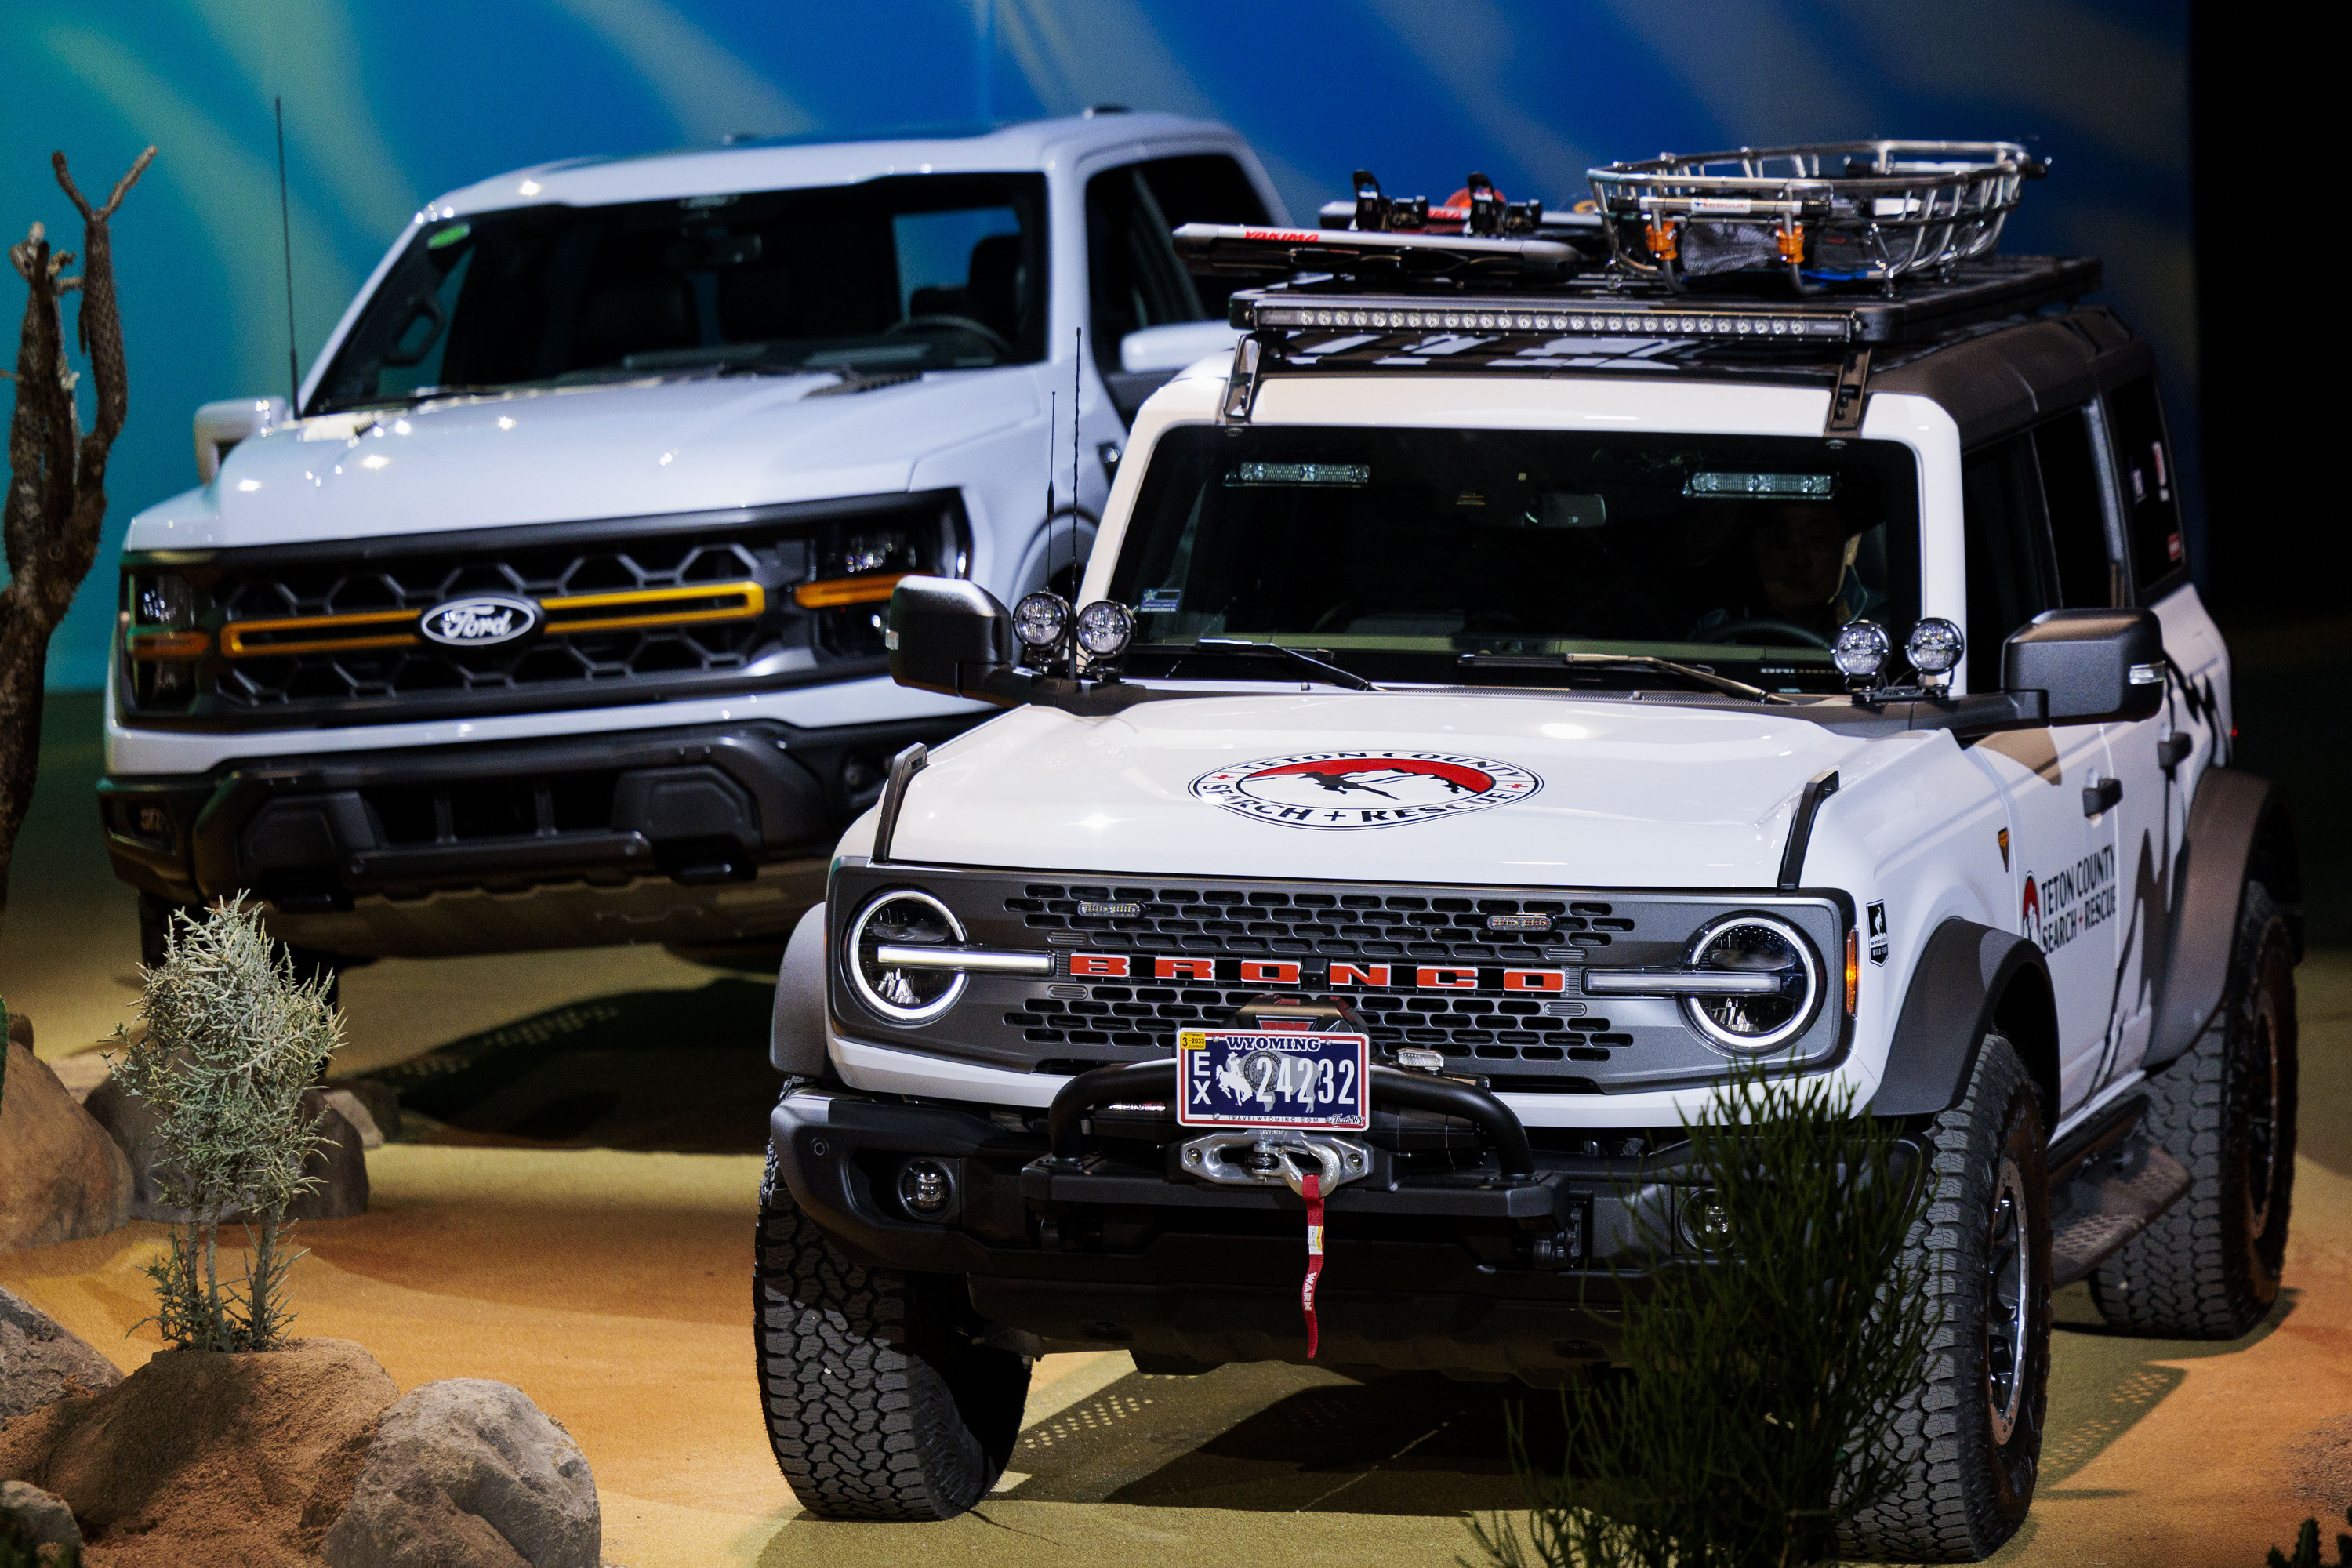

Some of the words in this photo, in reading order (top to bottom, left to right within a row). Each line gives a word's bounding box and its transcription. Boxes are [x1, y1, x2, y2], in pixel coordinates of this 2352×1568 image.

[1244, 230, 1319, 243] YAKIMA
[441, 605, 514, 639] Ford
[1236, 751, 1367, 770] TETON
[1382, 751, 1526, 779] COUNTY
[1203, 784, 1314, 821] SEARCH
[1361, 792, 1516, 822] RESCUE
[2041, 866, 2075, 919] TETON
[2076, 844, 2115, 898] COUNTY
[2042, 907, 2078, 955] SEARCH
[2085, 884, 2116, 931] RESCUE
[1070, 953, 1566, 993] BRONCO
[1225, 1036, 1321, 1051] WYOMING
[1256, 1056, 1356, 1105] 24232
[1227, 1115, 1319, 1123] TRAVELWYOMING.COM
[1303, 1272, 1318, 1312] WARN
